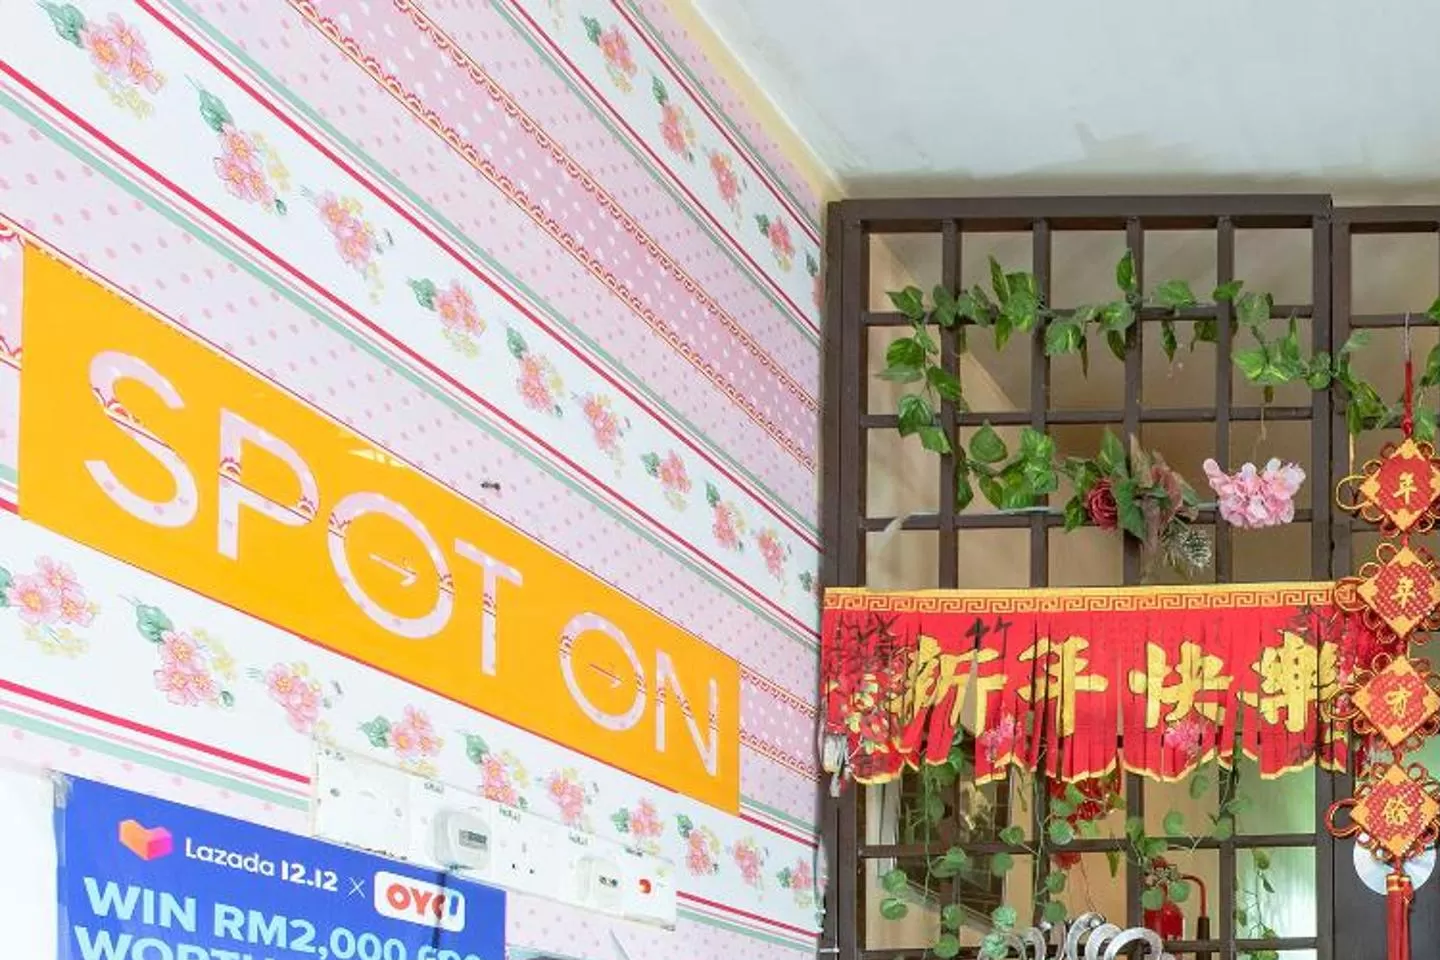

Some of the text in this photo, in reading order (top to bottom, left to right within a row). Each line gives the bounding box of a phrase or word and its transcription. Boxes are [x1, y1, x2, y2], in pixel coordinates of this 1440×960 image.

[83, 350, 719, 777] SPOT ON
[185, 837, 275, 877] Lazada
[281, 859, 338, 892] 12.12
[83, 876, 196, 932] WIN
